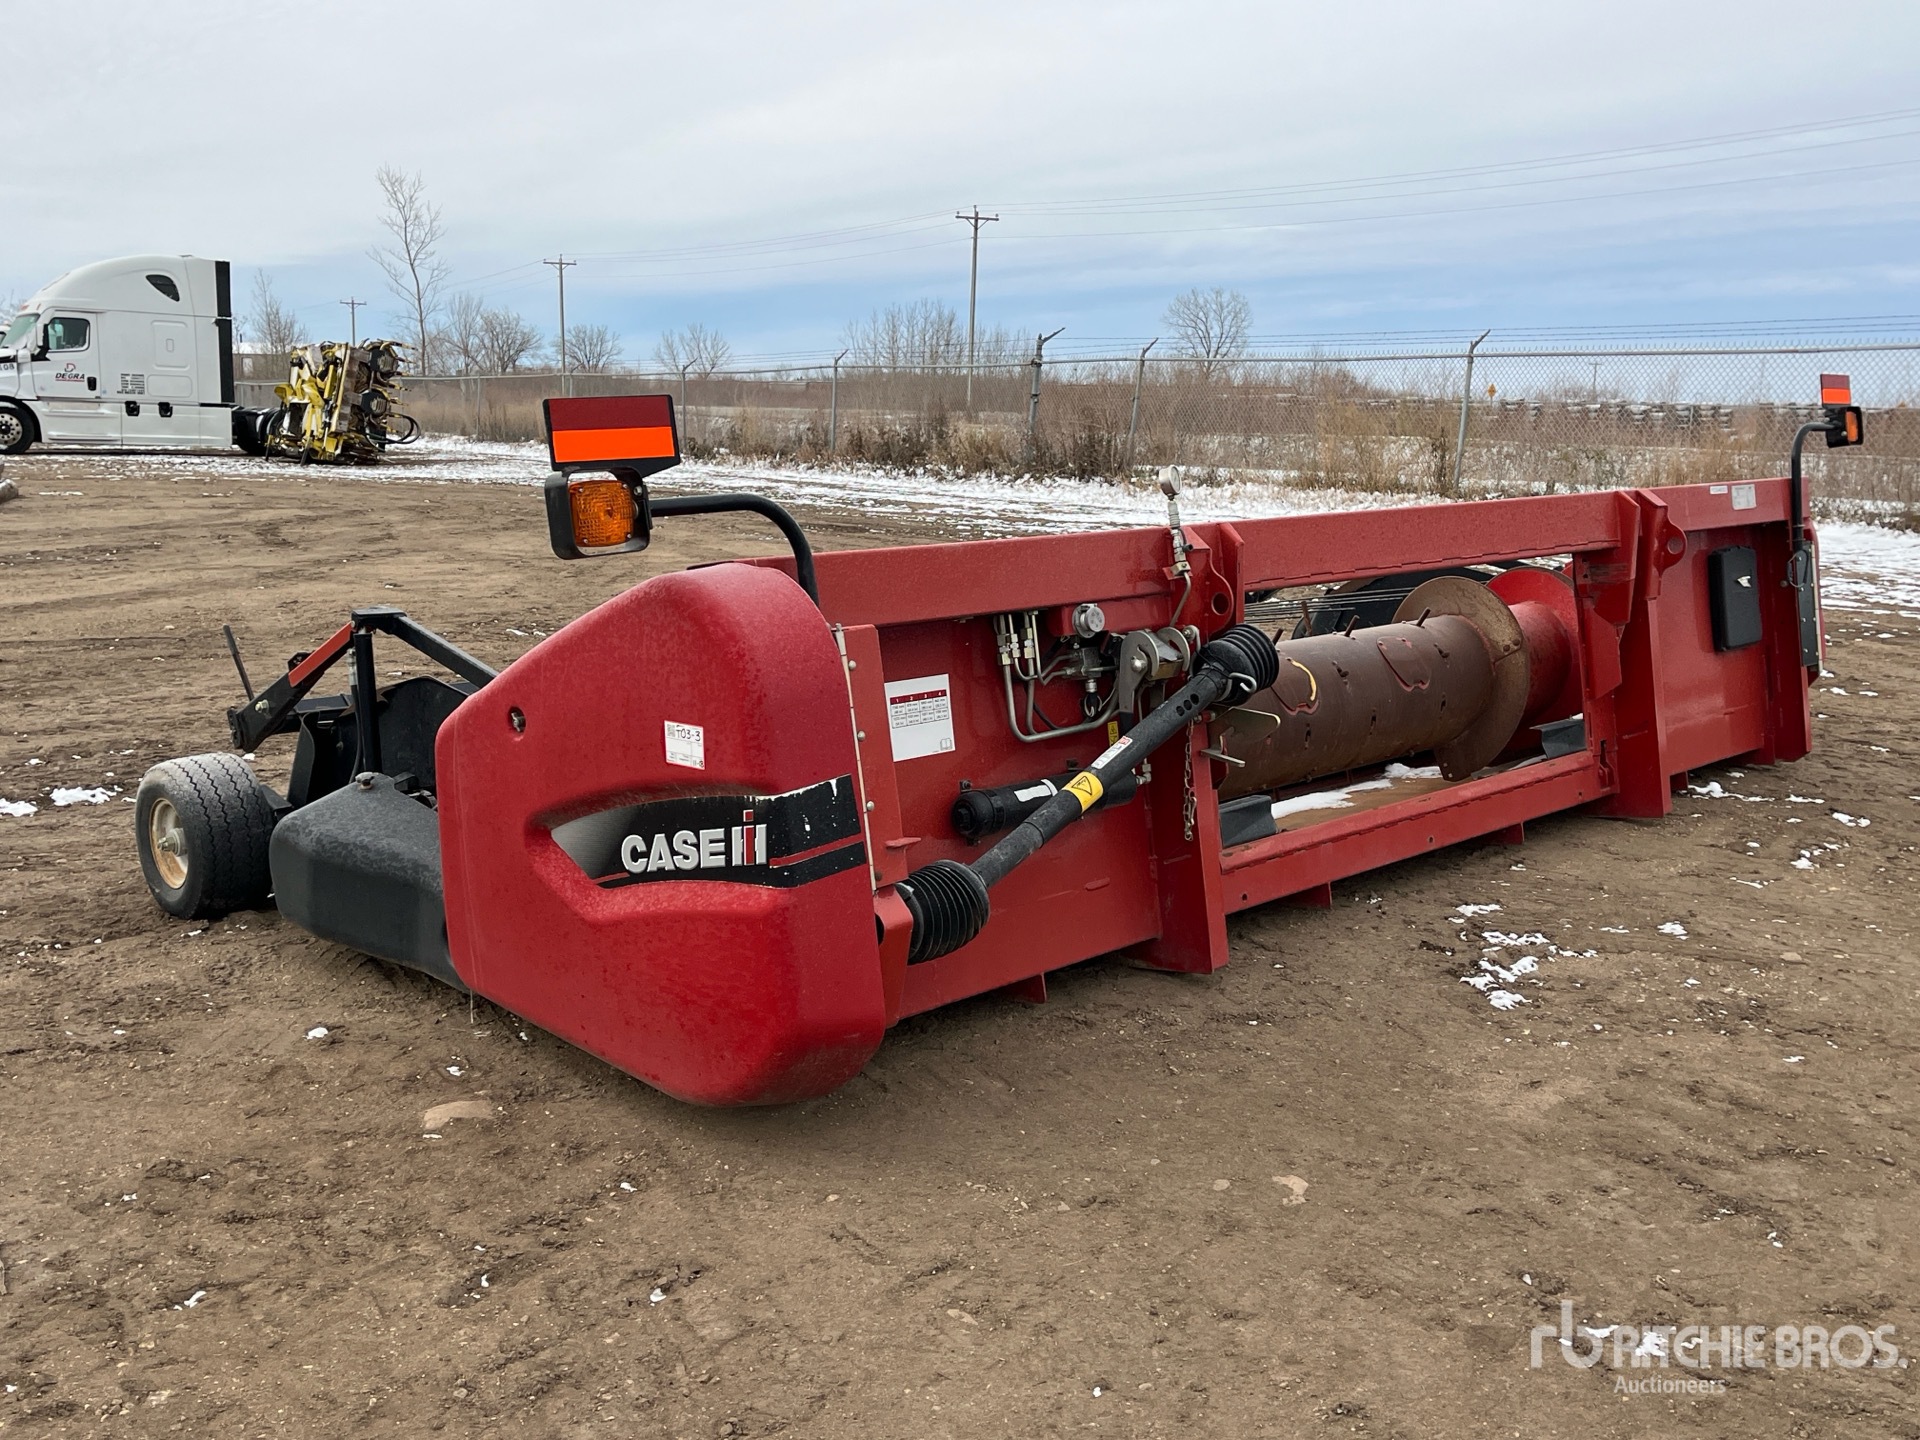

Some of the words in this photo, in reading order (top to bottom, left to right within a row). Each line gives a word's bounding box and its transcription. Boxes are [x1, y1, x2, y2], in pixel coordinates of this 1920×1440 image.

[55, 372, 85, 380] DEGRA
[676, 728, 701, 742] T03-3
[621, 828, 726, 874] CASE
